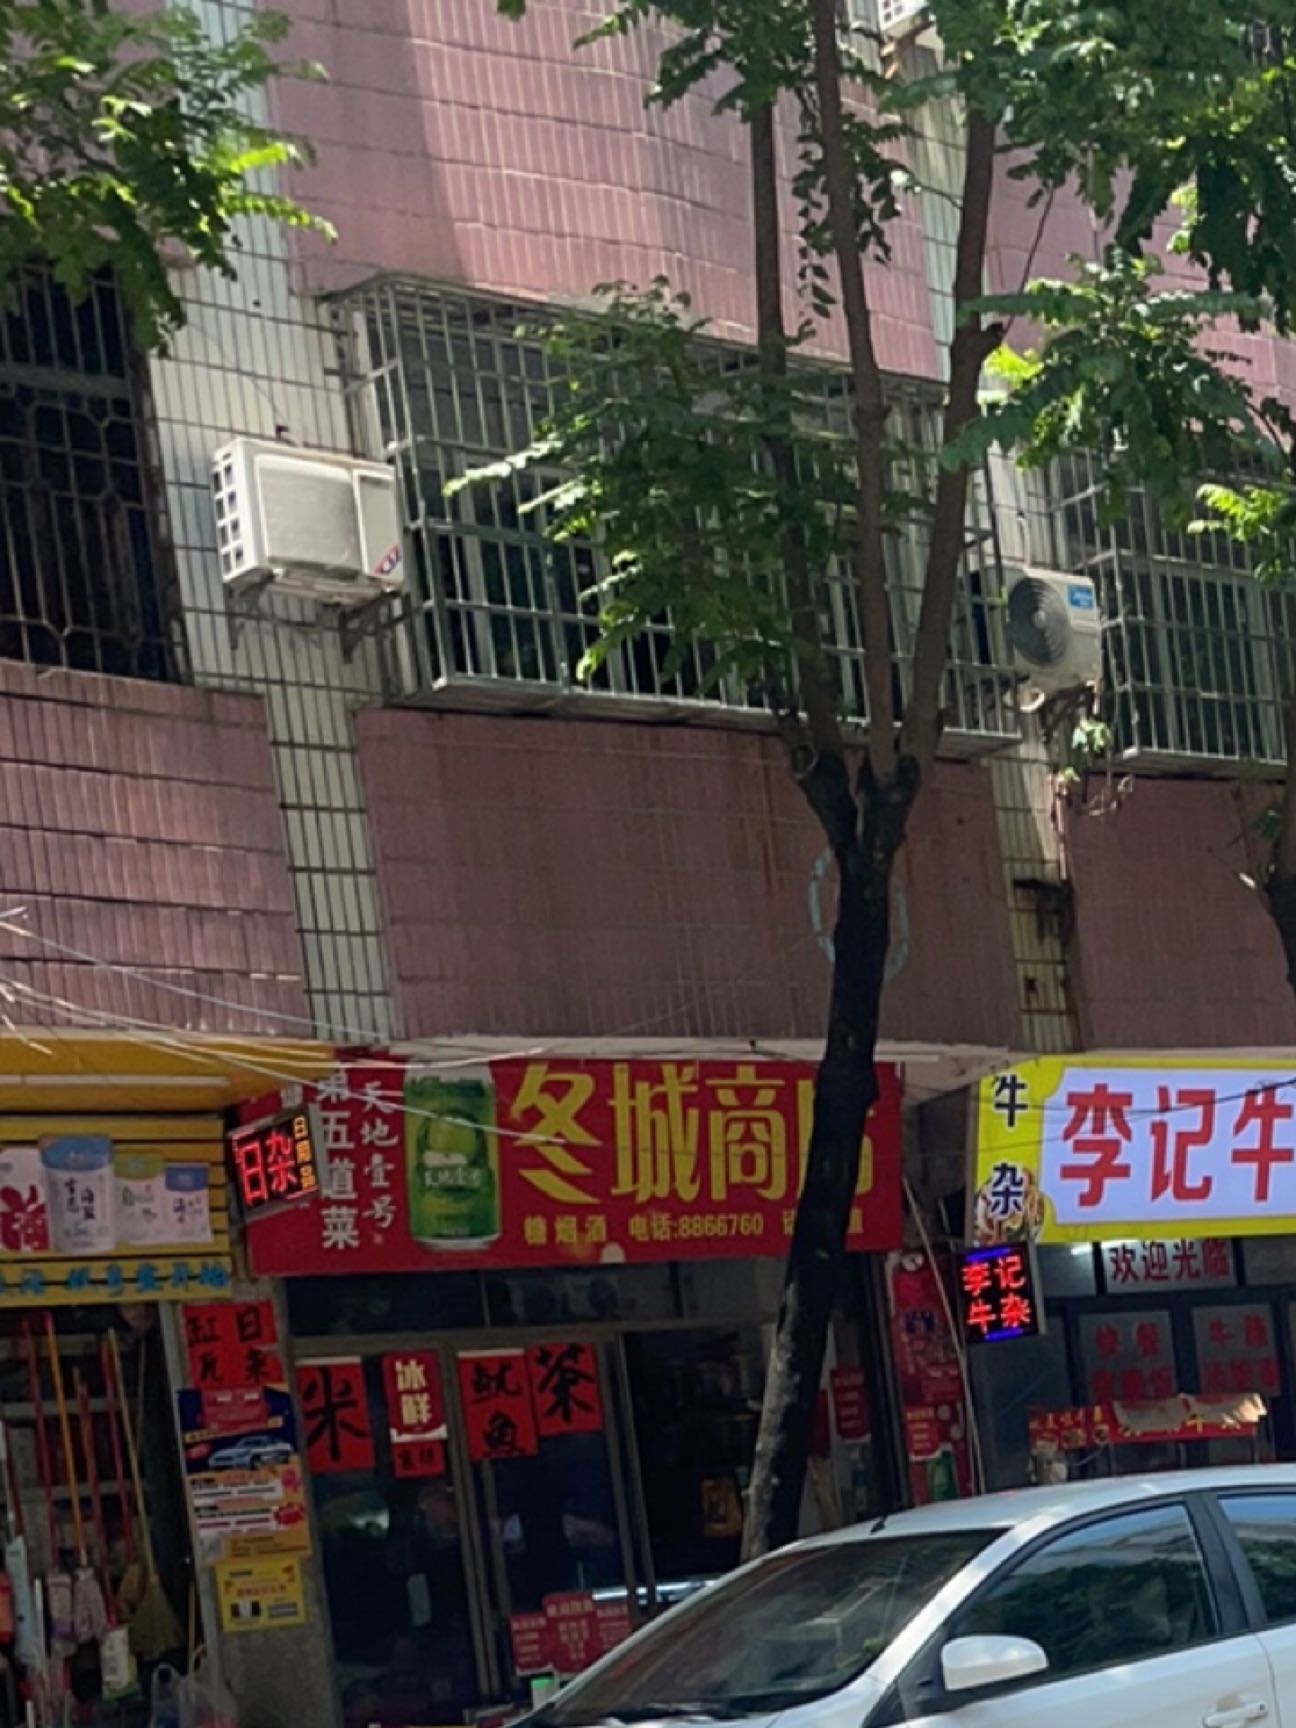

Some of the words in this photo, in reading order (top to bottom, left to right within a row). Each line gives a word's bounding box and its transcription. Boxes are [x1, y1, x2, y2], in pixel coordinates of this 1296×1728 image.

[358, 1080, 399, 1229] 天地壹号
[510, 1062, 874, 1204] 冬城商
[993, 1074, 1027, 1215] 牛杂
[961, 1256, 1025, 1295] 李记
[1108, 1240, 1230, 1284] 欢迎光临
[303, 1366, 366, 1460] 米
